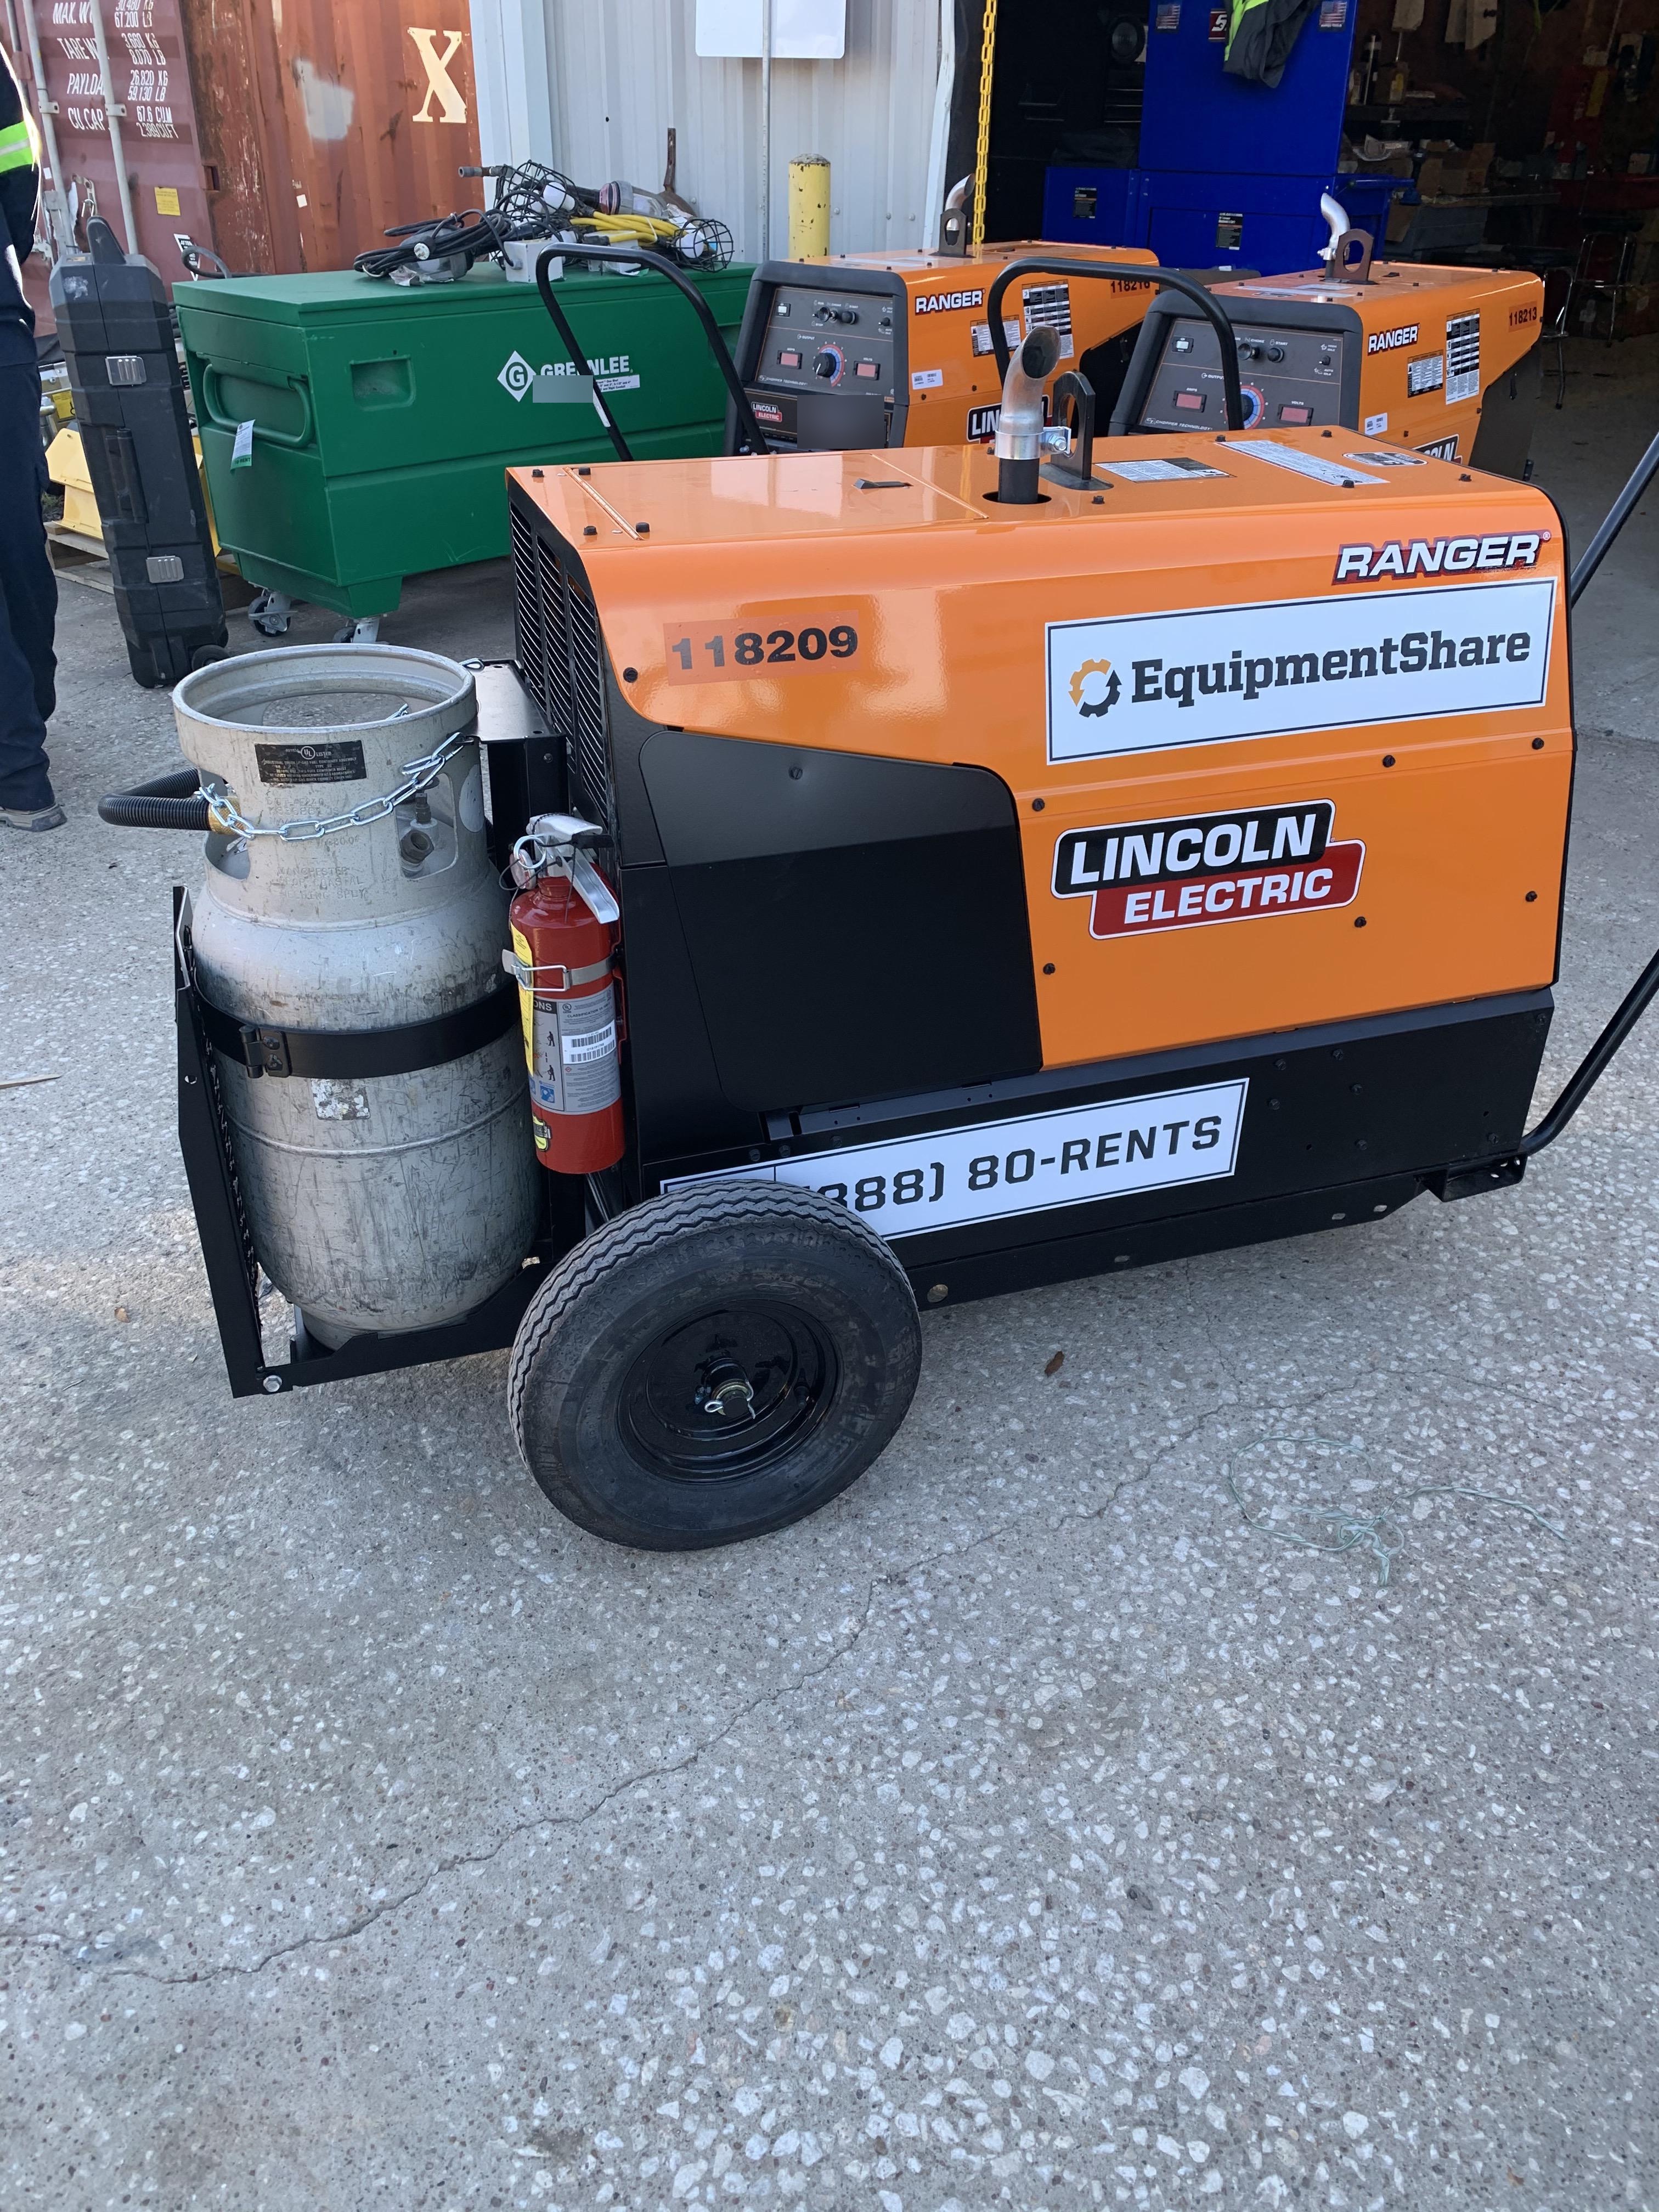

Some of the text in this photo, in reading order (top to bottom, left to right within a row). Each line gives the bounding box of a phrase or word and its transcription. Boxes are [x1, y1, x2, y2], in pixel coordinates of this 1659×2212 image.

[53, 3, 76, 24] MAX.
[114, 12, 153, 27] 67.200 LB
[57, 37, 90, 59] TARE
[121, 33, 160, 49] 3.660 KG
[128, 49, 166, 65] 8.070 LB
[66, 73, 105, 95] PAYLOA
[130, 70, 168, 87] 26.820 KG
[407, 27, 467, 123] X
[127, 86, 167, 101] 59.130 LB
[137, 105, 154, 122] 67.6
[915, 289, 984, 314] RANGER
[1509, 306, 1538, 326] 118213
[1368, 325, 1419, 354] RANGER
[509, 365, 524, 387] G
[540, 356, 630, 376] GRENLEE
[753, 403, 777, 413] LINCOLN
[1336, 534, 1541, 579] RANGER
[672, 625, 858, 670] 118209
[1131, 630, 1531, 709] EquipmentShare
[1070, 814, 1317, 885] LINCOLN
[1124, 868, 1333, 924] ELECTRIC
[967, 1115, 1222, 1192] 80-RENTS
